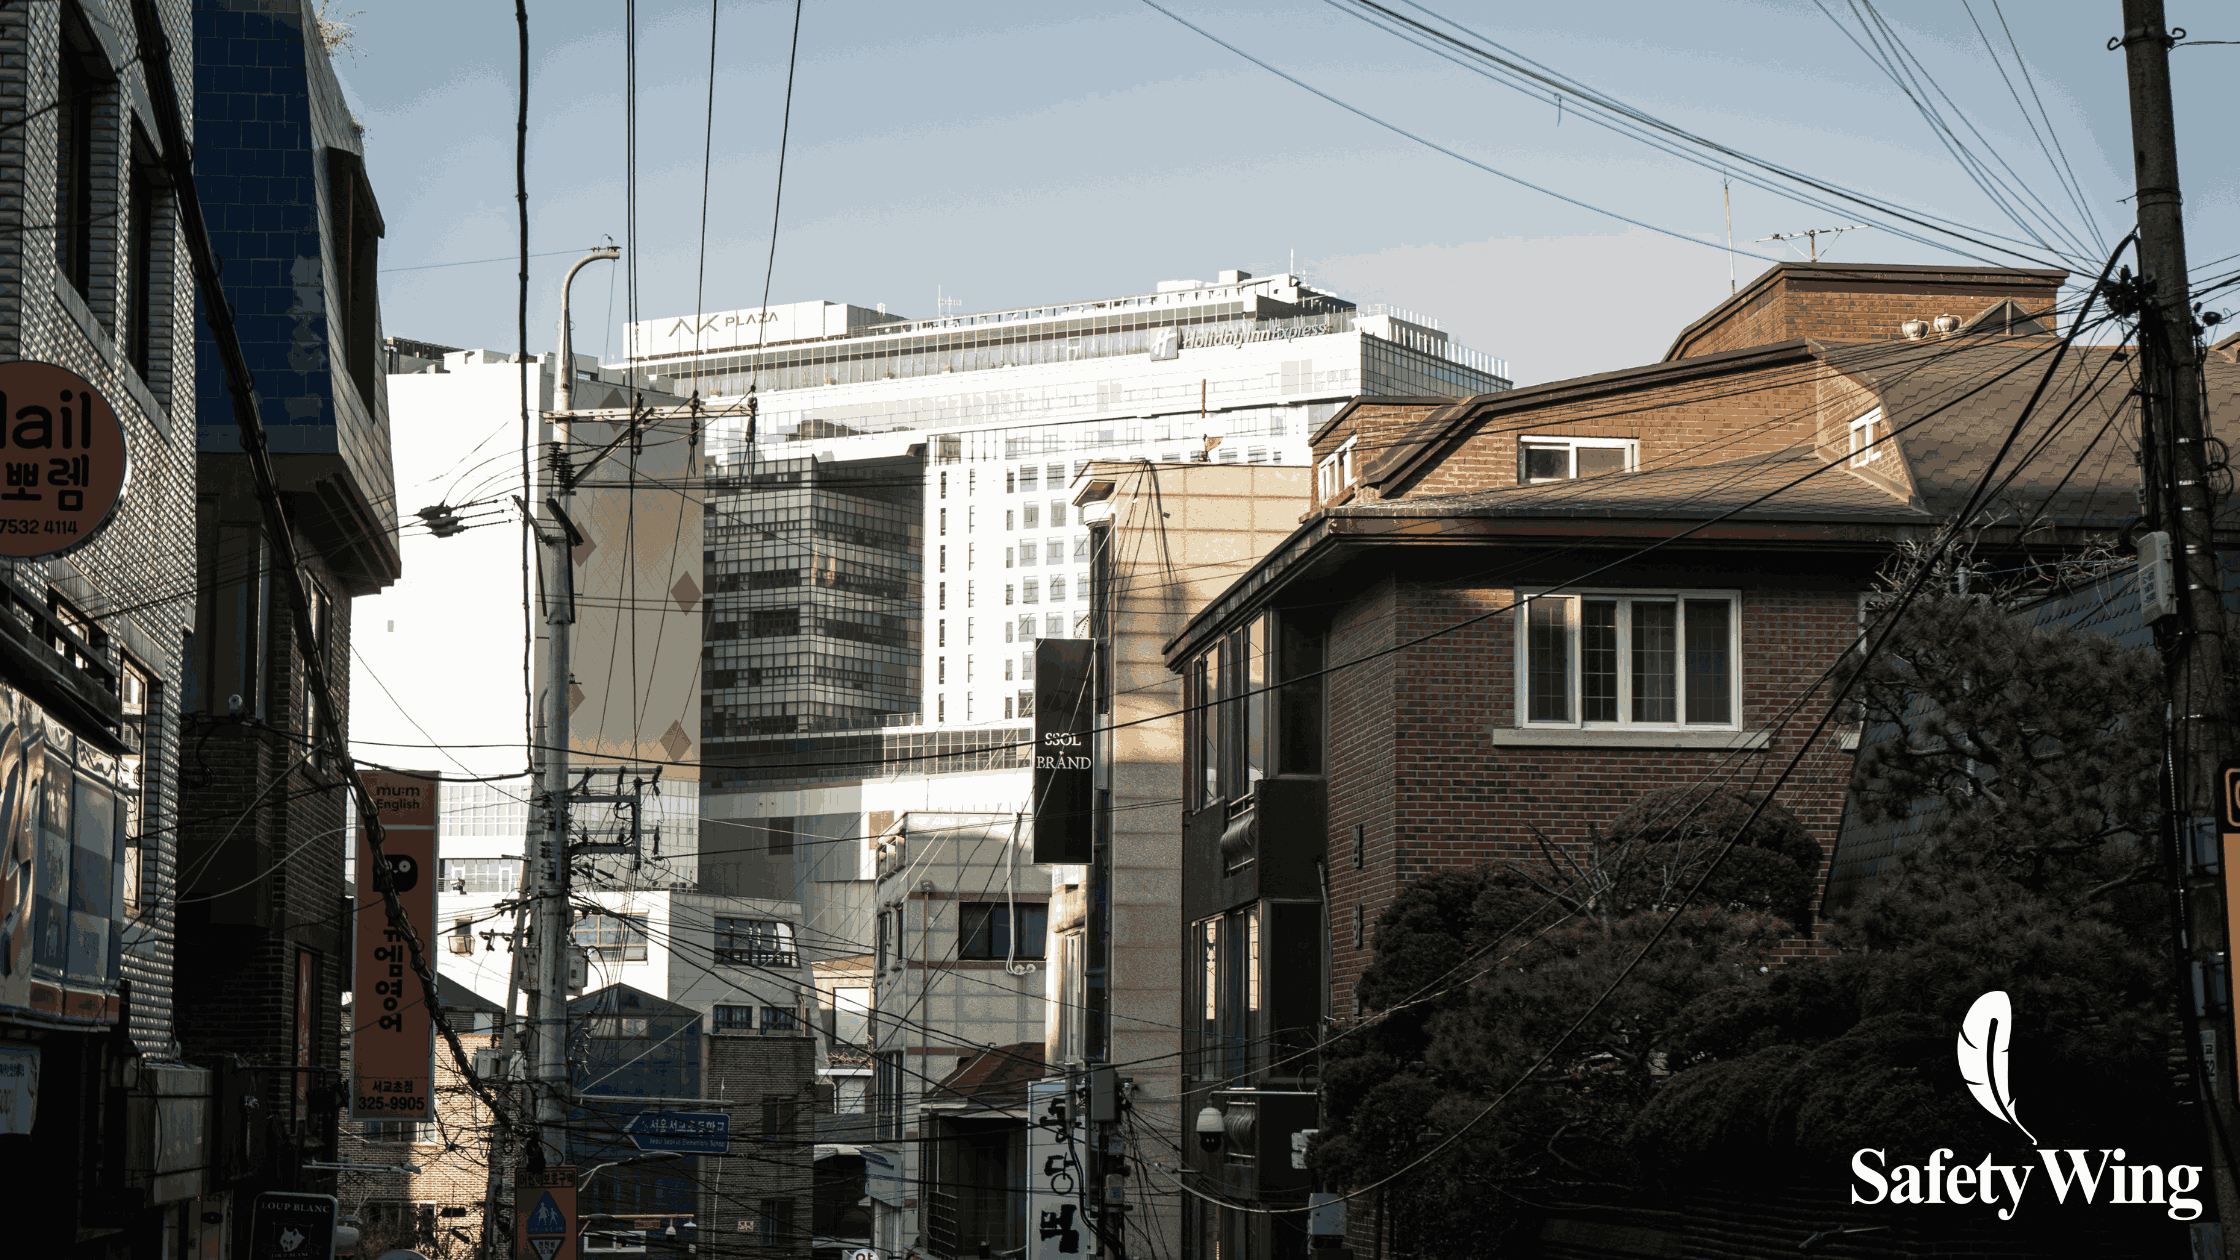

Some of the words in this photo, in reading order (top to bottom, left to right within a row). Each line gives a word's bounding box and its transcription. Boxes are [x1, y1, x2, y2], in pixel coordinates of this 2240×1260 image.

[725, 311, 779, 327] PLAZA
[0, 389, 92, 450] ail
[43, 520, 78, 535] 4114
[1045, 732, 1081, 746] SSOL
[1036, 756, 1092, 770] BRAND
[377, 799, 420, 811] English
[358, 1096, 426, 1111] 325-9905
[261, 1201, 290, 1211] LOUP
[294, 1203, 330, 1214] BLANC
